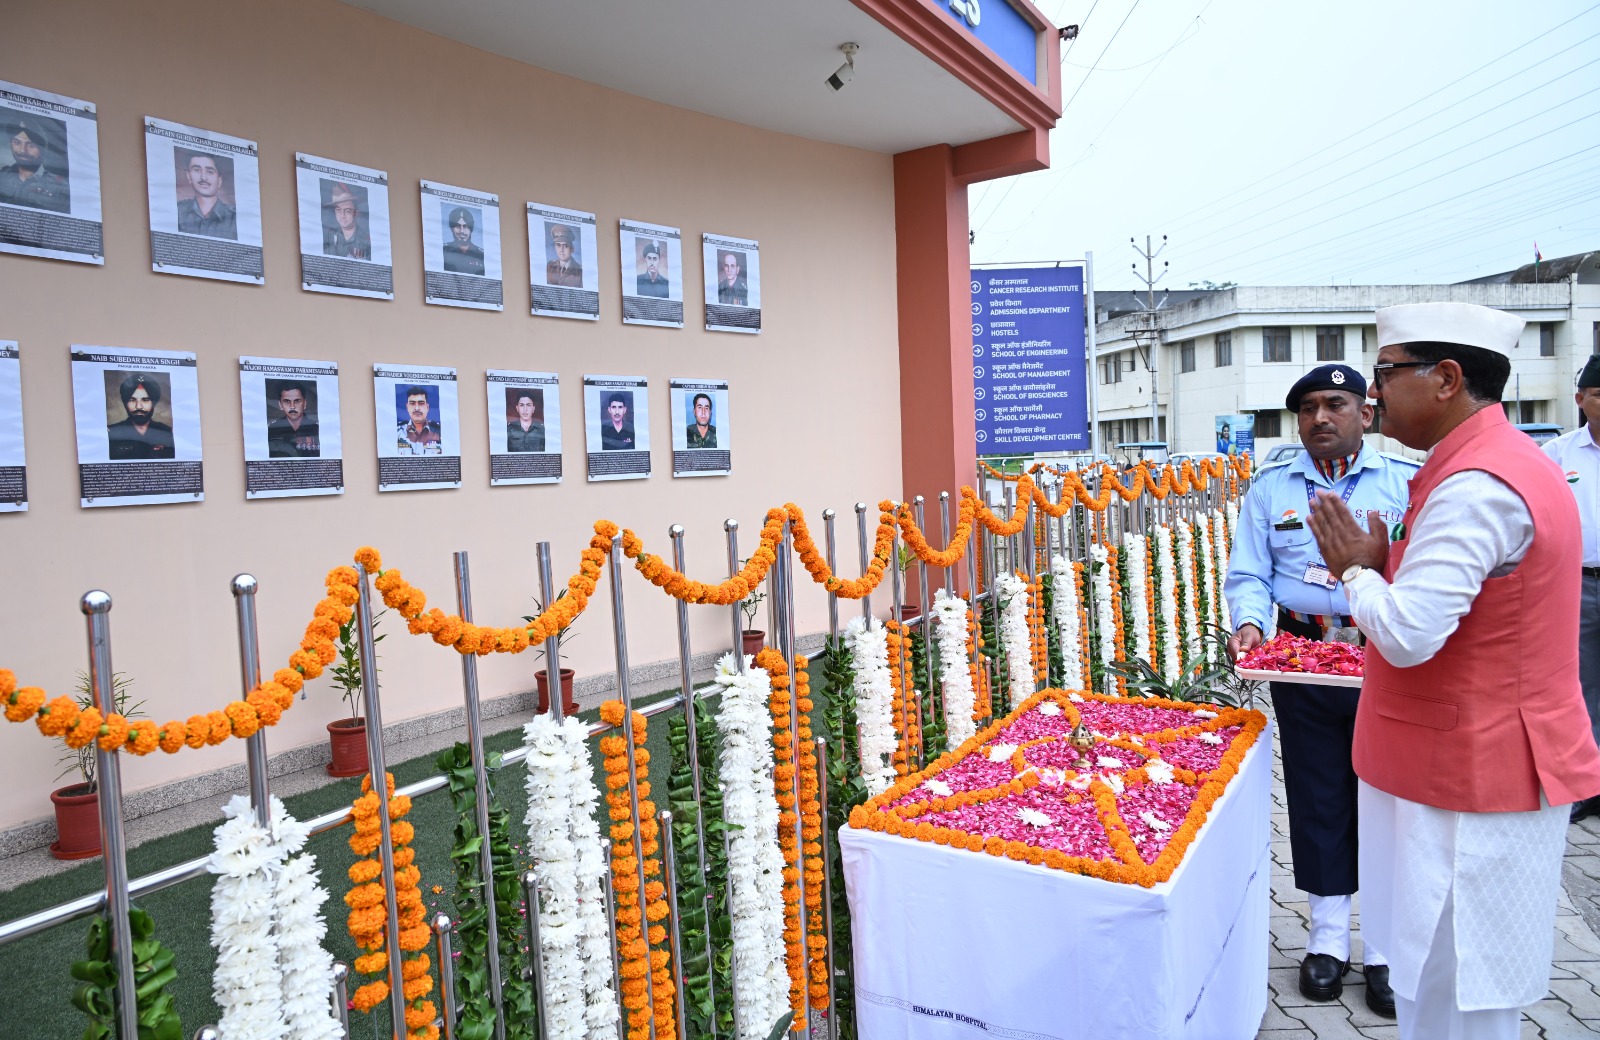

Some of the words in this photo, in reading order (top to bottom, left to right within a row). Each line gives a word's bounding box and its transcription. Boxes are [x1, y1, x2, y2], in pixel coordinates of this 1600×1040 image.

[7, 93, 25, 102] NAIK
[26, 98, 52, 109] KARAM
[54, 105, 76, 115] SINGH
[150, 127, 175, 138] CAPTAIN
[213, 142, 230, 150] SINGH
[913, 1006, 953, 1019] HIMALAYAN
[955, 1014, 988, 1030] HOSPITAL
